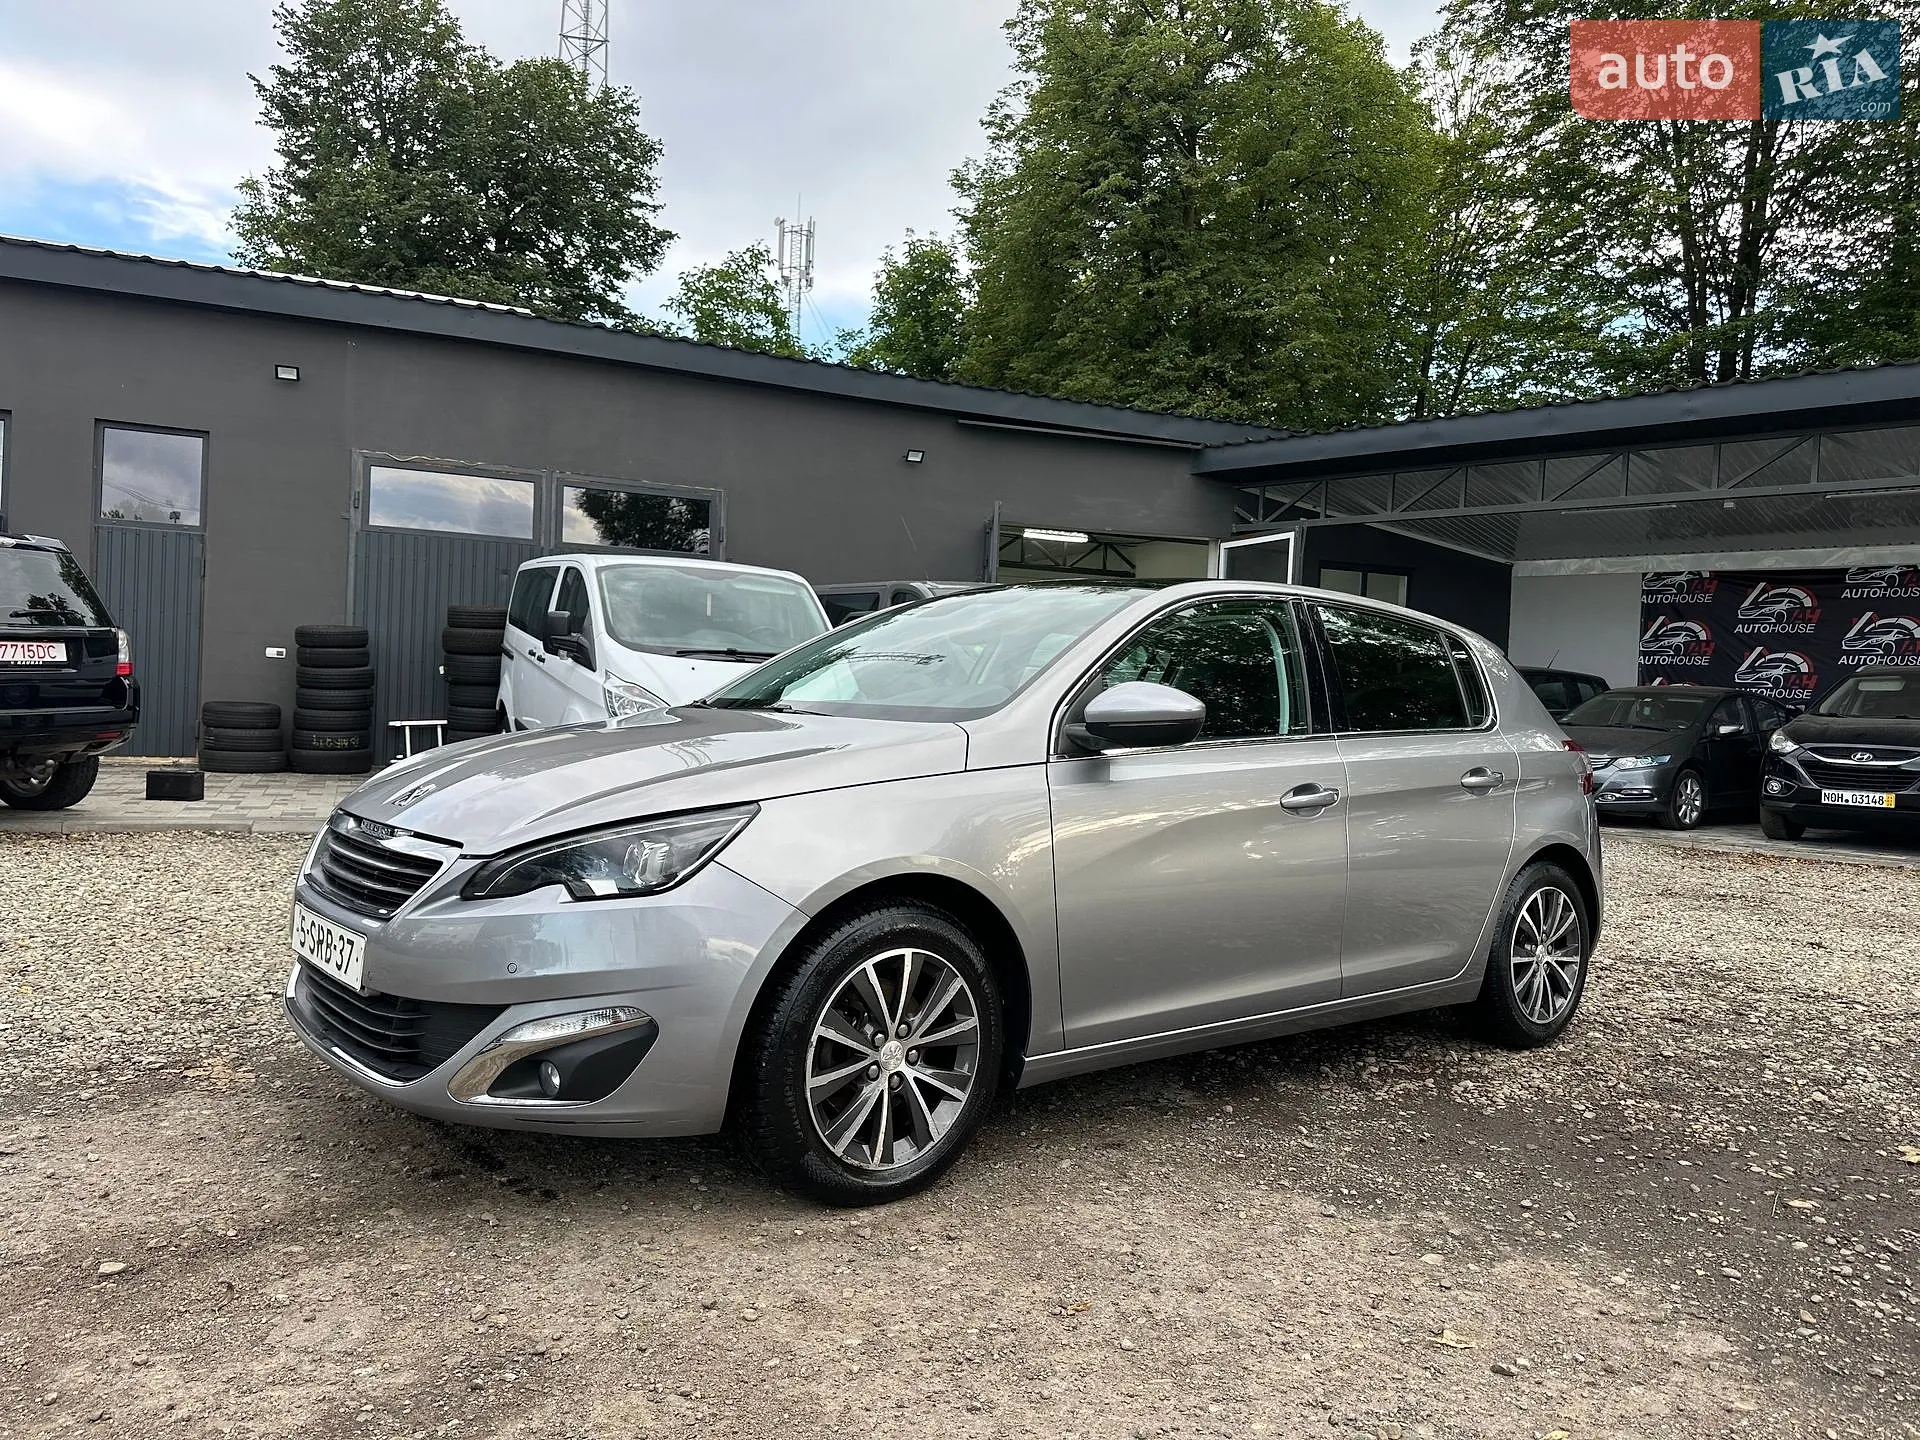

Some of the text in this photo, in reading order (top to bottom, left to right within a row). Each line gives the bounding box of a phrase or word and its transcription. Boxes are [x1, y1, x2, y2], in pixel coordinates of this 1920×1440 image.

[1641, 593, 1713, 604] AUTOHOUSE
[1734, 623, 1816, 634] AUTOHOUSE
[1638, 655, 1711, 666] AUTOHOUSE
[299, 914, 355, 975] 5-SRB-37
